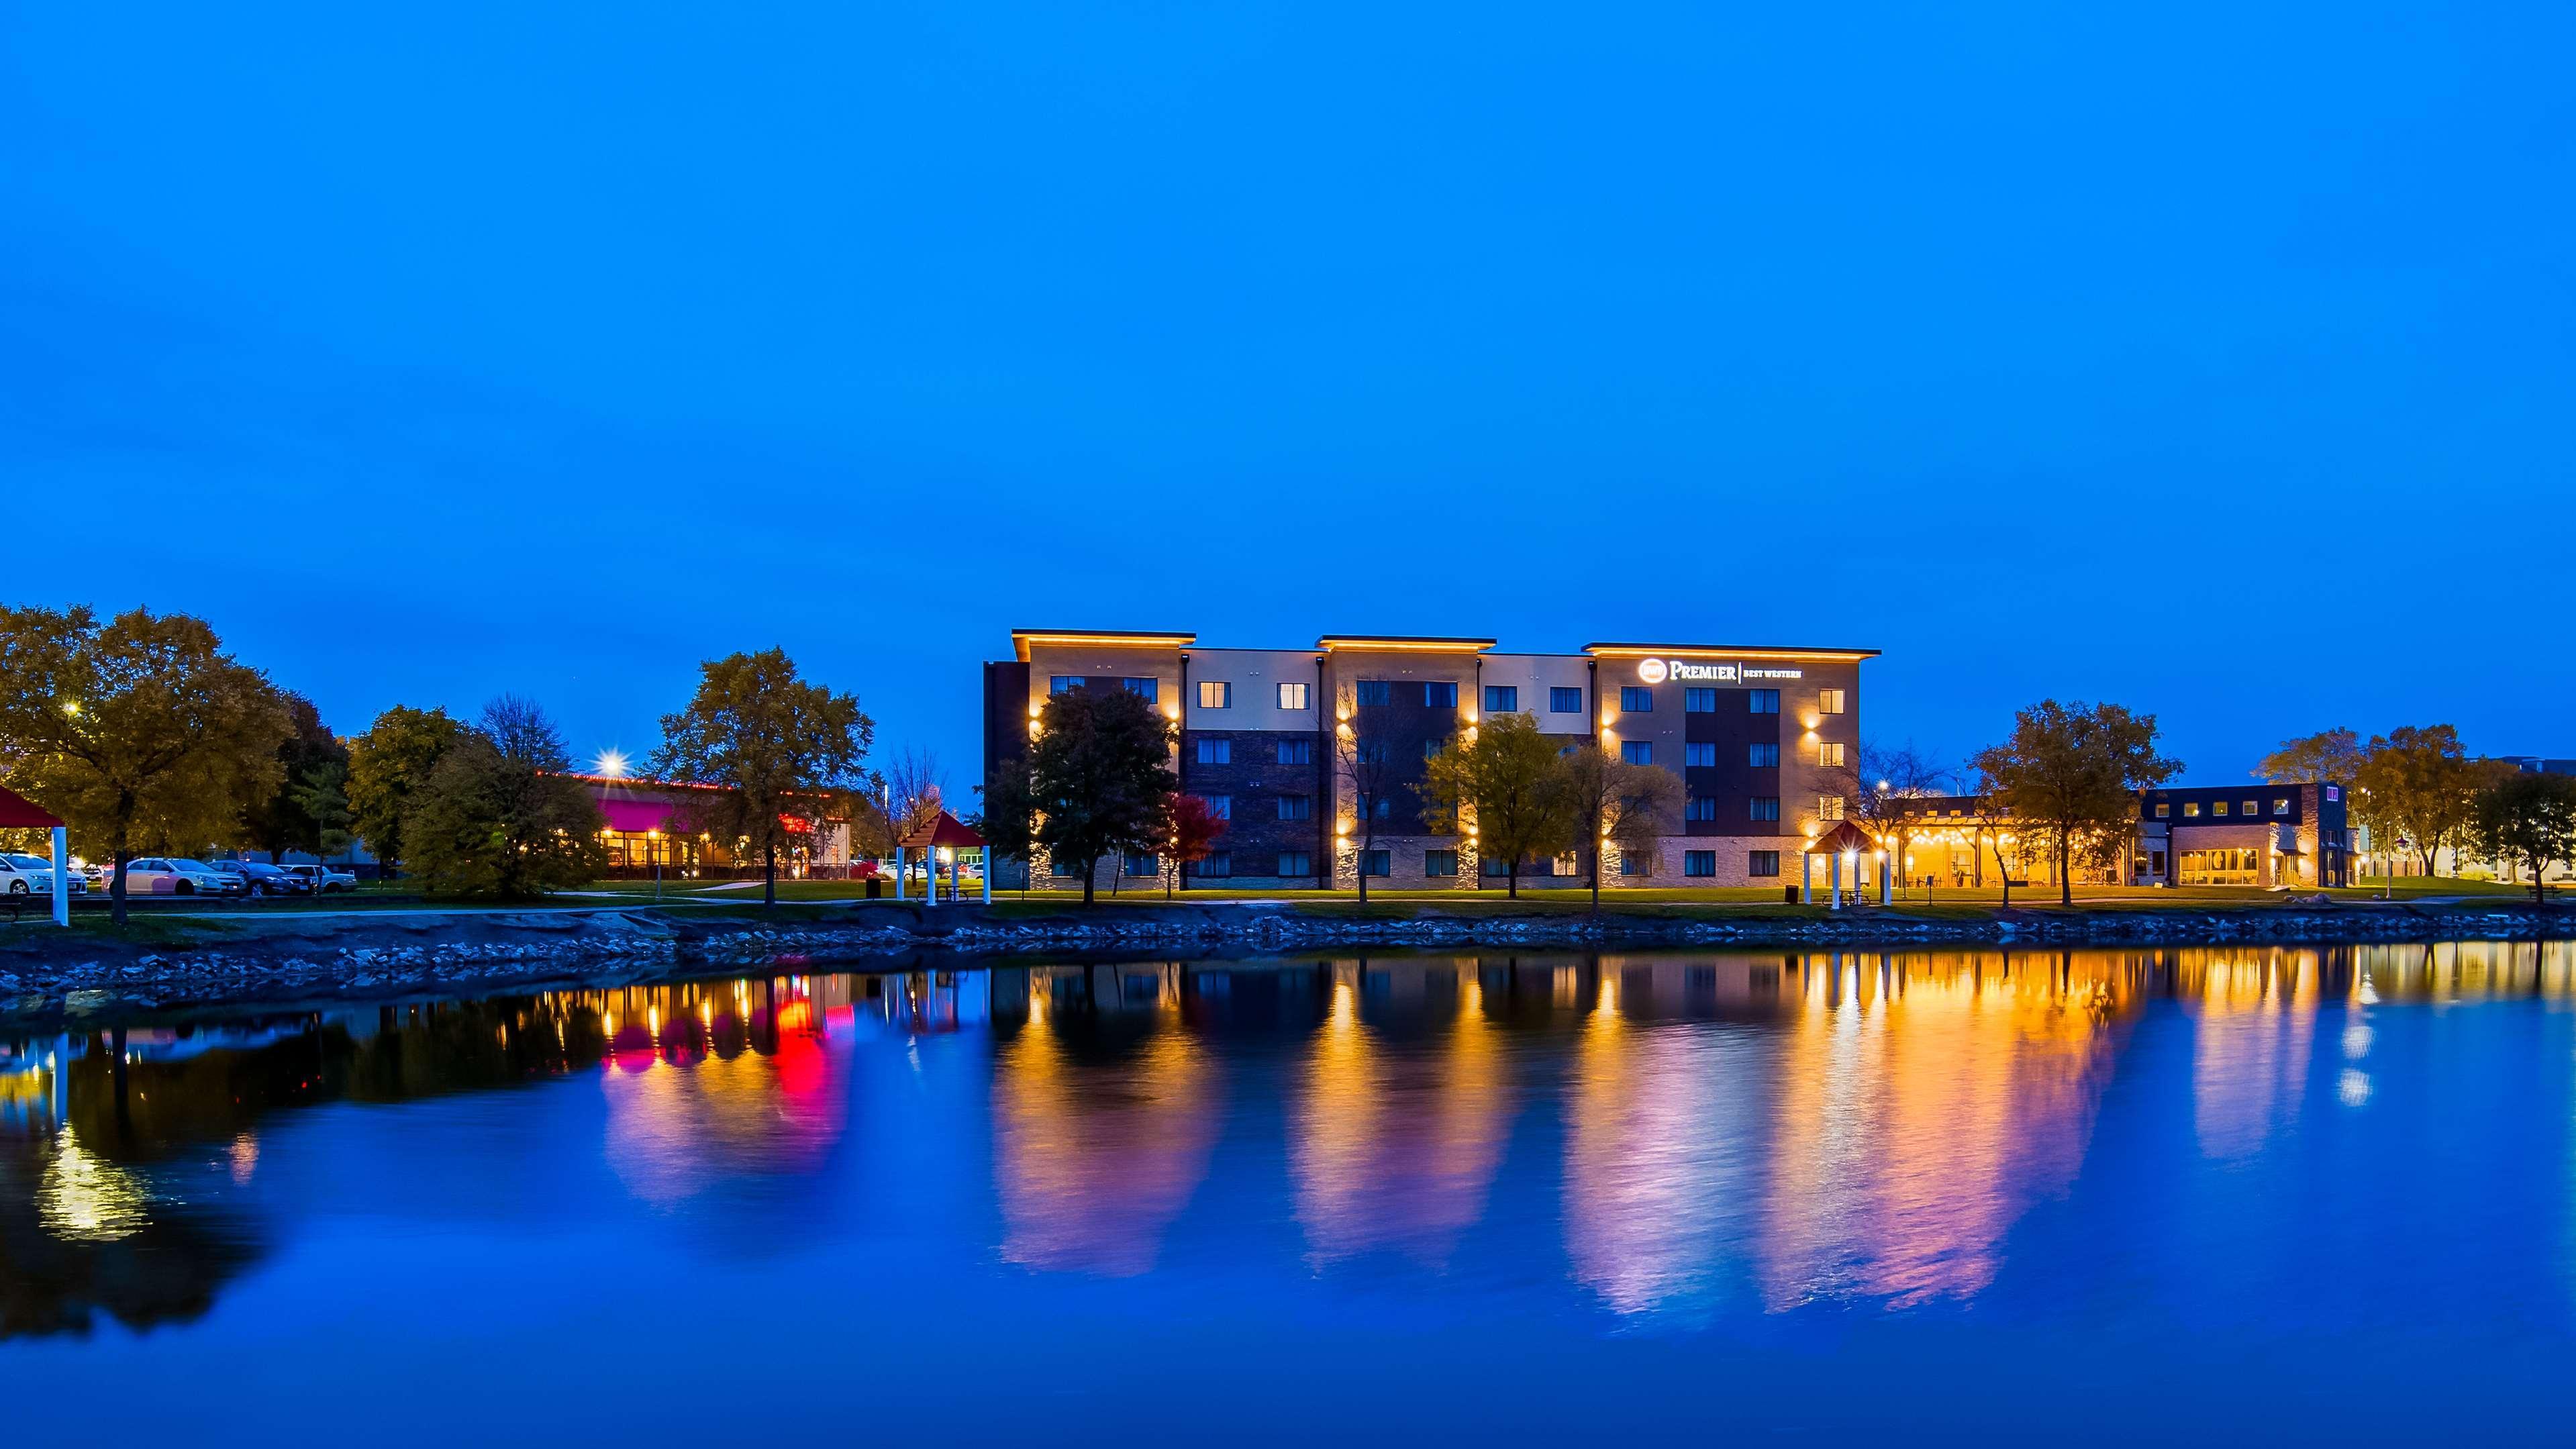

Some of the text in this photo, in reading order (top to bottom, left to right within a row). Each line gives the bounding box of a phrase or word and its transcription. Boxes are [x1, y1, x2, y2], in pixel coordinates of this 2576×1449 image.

[1669, 660, 1802, 680] PREMIER BEST WESTERN
